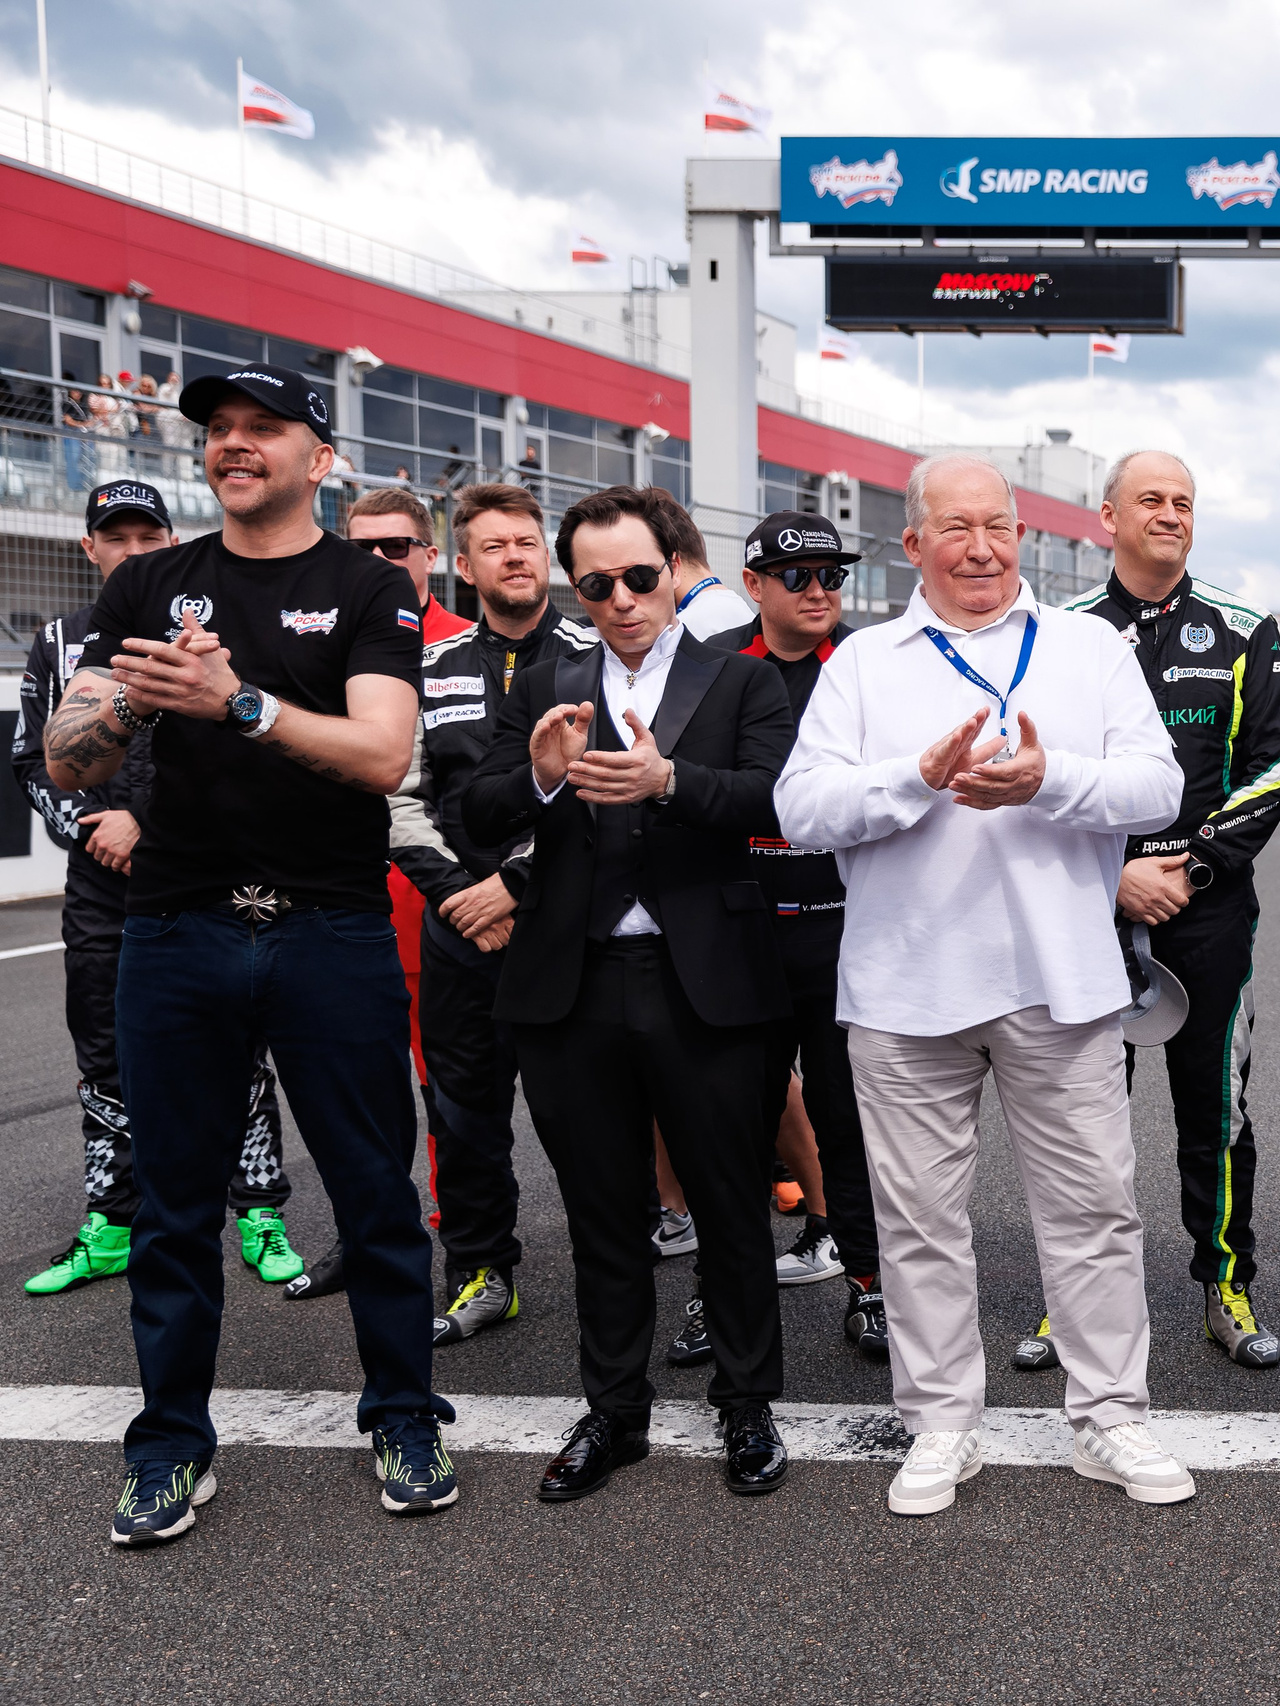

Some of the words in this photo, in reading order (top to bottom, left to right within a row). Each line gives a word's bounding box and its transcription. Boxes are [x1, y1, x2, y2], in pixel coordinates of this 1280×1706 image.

[978, 168, 1042, 194] SMP
[1044, 168, 1149, 195] RACING
[936, 272, 1036, 291] MOSCOW
[241, 372, 285, 388] RACING
[1230, 614, 1256, 630] OMP
[965, 668, 987, 687] RACING
[1177, 669, 1197, 677] SMP
[1197, 670, 1233, 681] RACING
[454, 709, 484, 717] RACING
